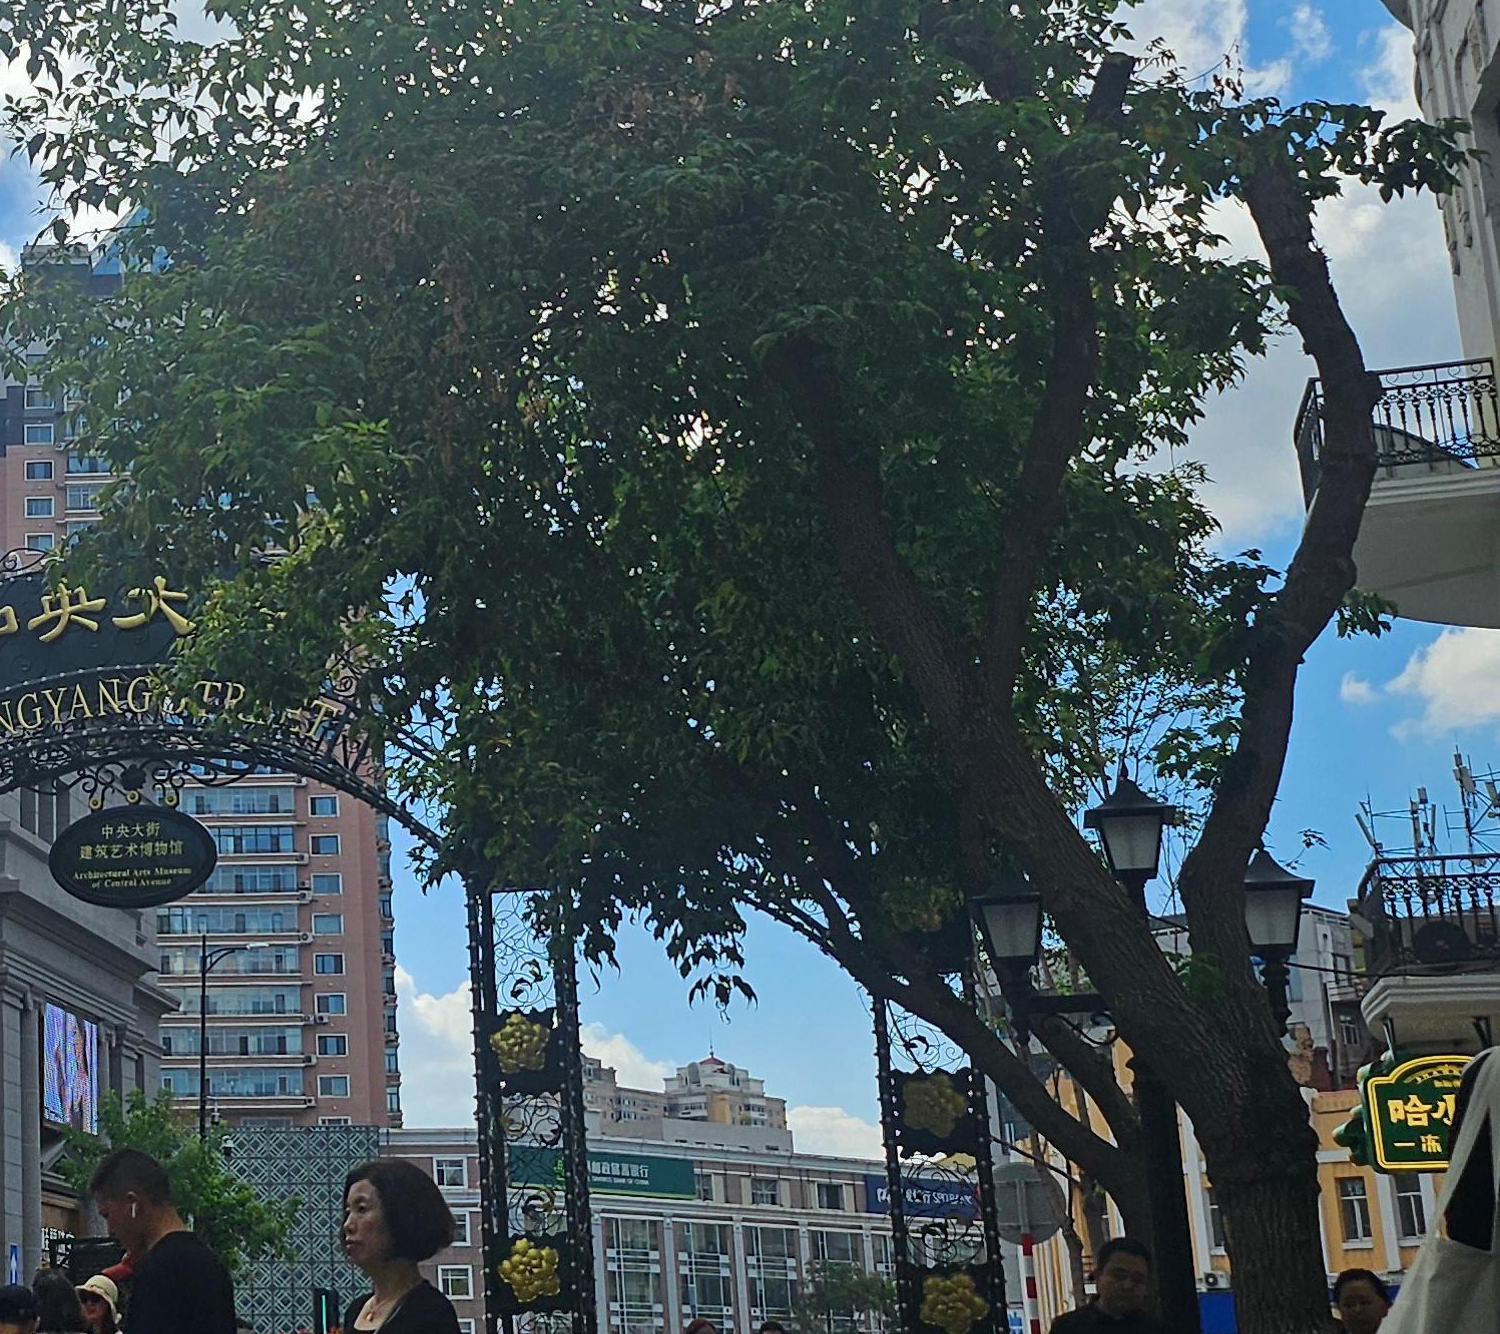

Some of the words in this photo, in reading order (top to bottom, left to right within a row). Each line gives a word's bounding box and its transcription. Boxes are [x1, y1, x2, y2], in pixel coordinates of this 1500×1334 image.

[101, 820, 161, 840] 中央大街
[79, 839, 184, 860] 建筑艺术博物馆
[73, 867, 130, 881] Architectural
[132, 868, 151, 879] Arts
[153, 866, 192, 876] Museum
[91, 880, 101, 889] of
[104, 878, 137, 889] Central
[140, 877, 172, 887] Avenue
[1393, 1133, 1443, 1153] 一冻
[587, 1160, 649, 1178] 邮政储蓄银行
